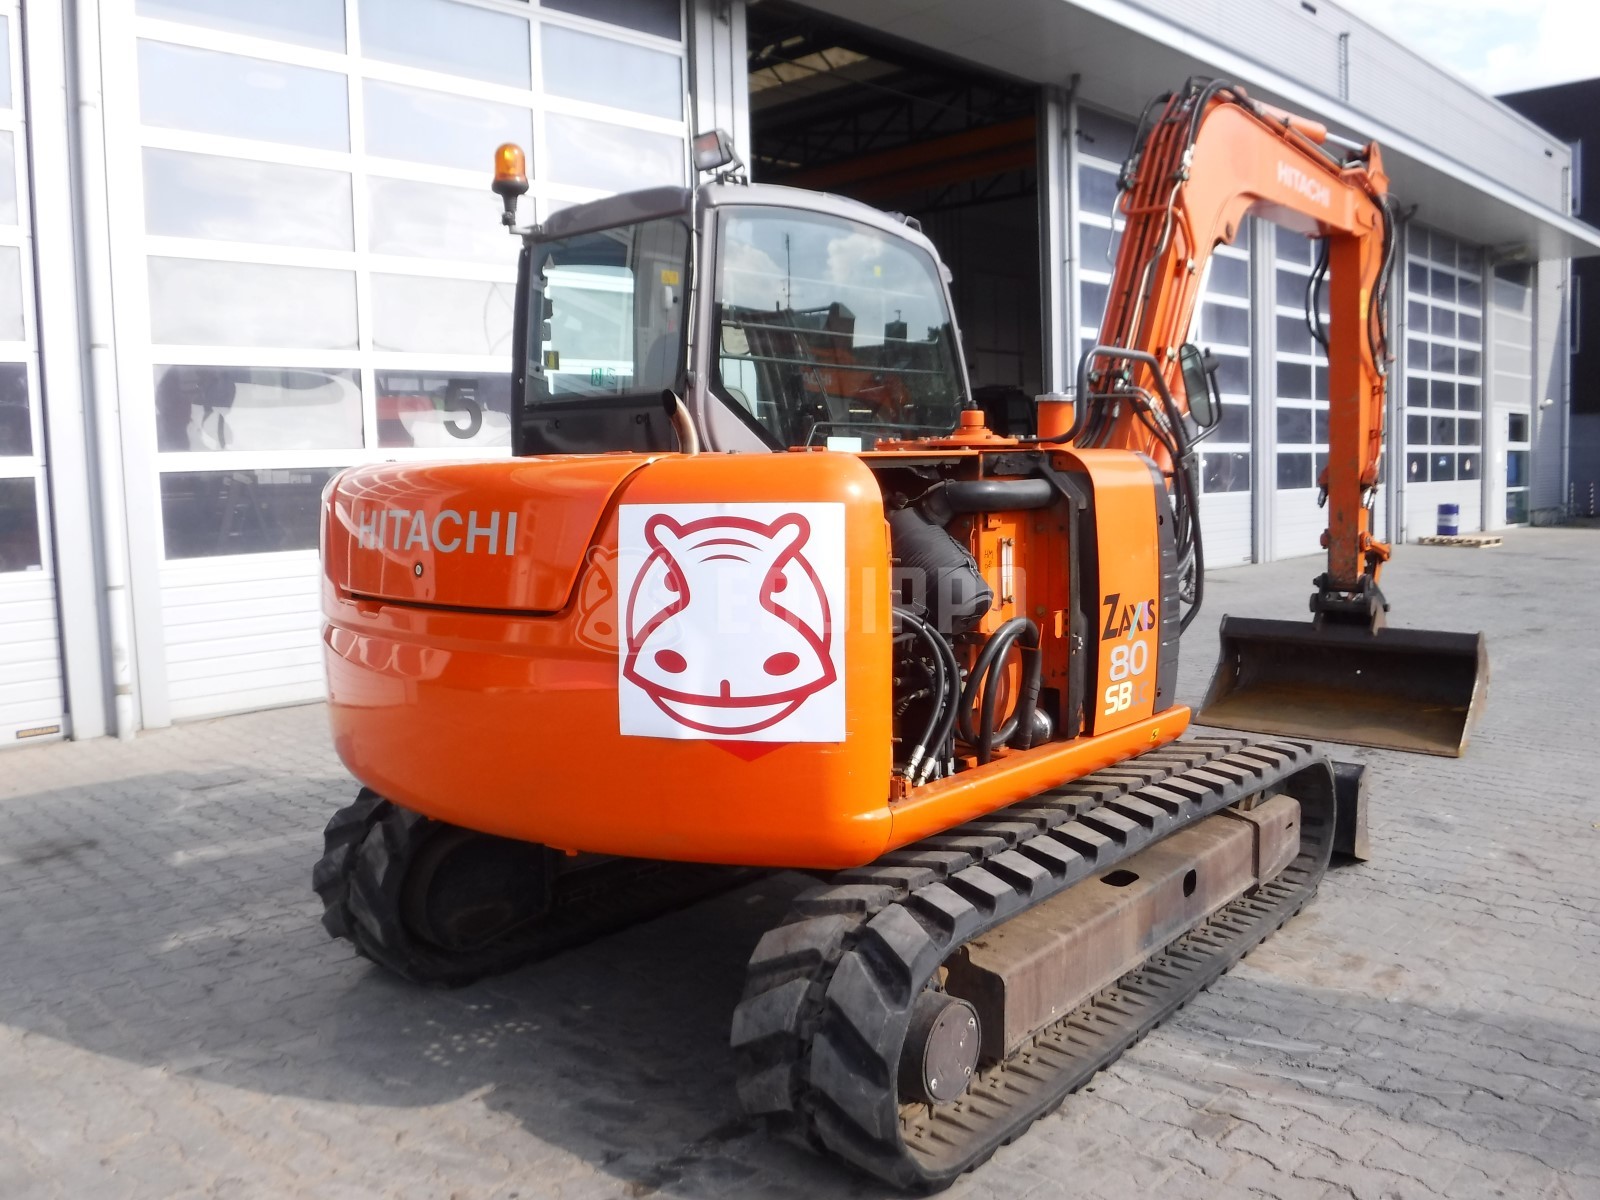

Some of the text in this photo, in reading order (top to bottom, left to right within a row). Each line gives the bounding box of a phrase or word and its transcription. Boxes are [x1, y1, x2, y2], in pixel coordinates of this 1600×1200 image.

[1276, 159, 1331, 209] HITACHI
[443, 378, 483, 440] 5
[358, 509, 518, 556] HITACHI
[1101, 593, 1156, 641] ZAXIS
[1109, 640, 1148, 682] 80
